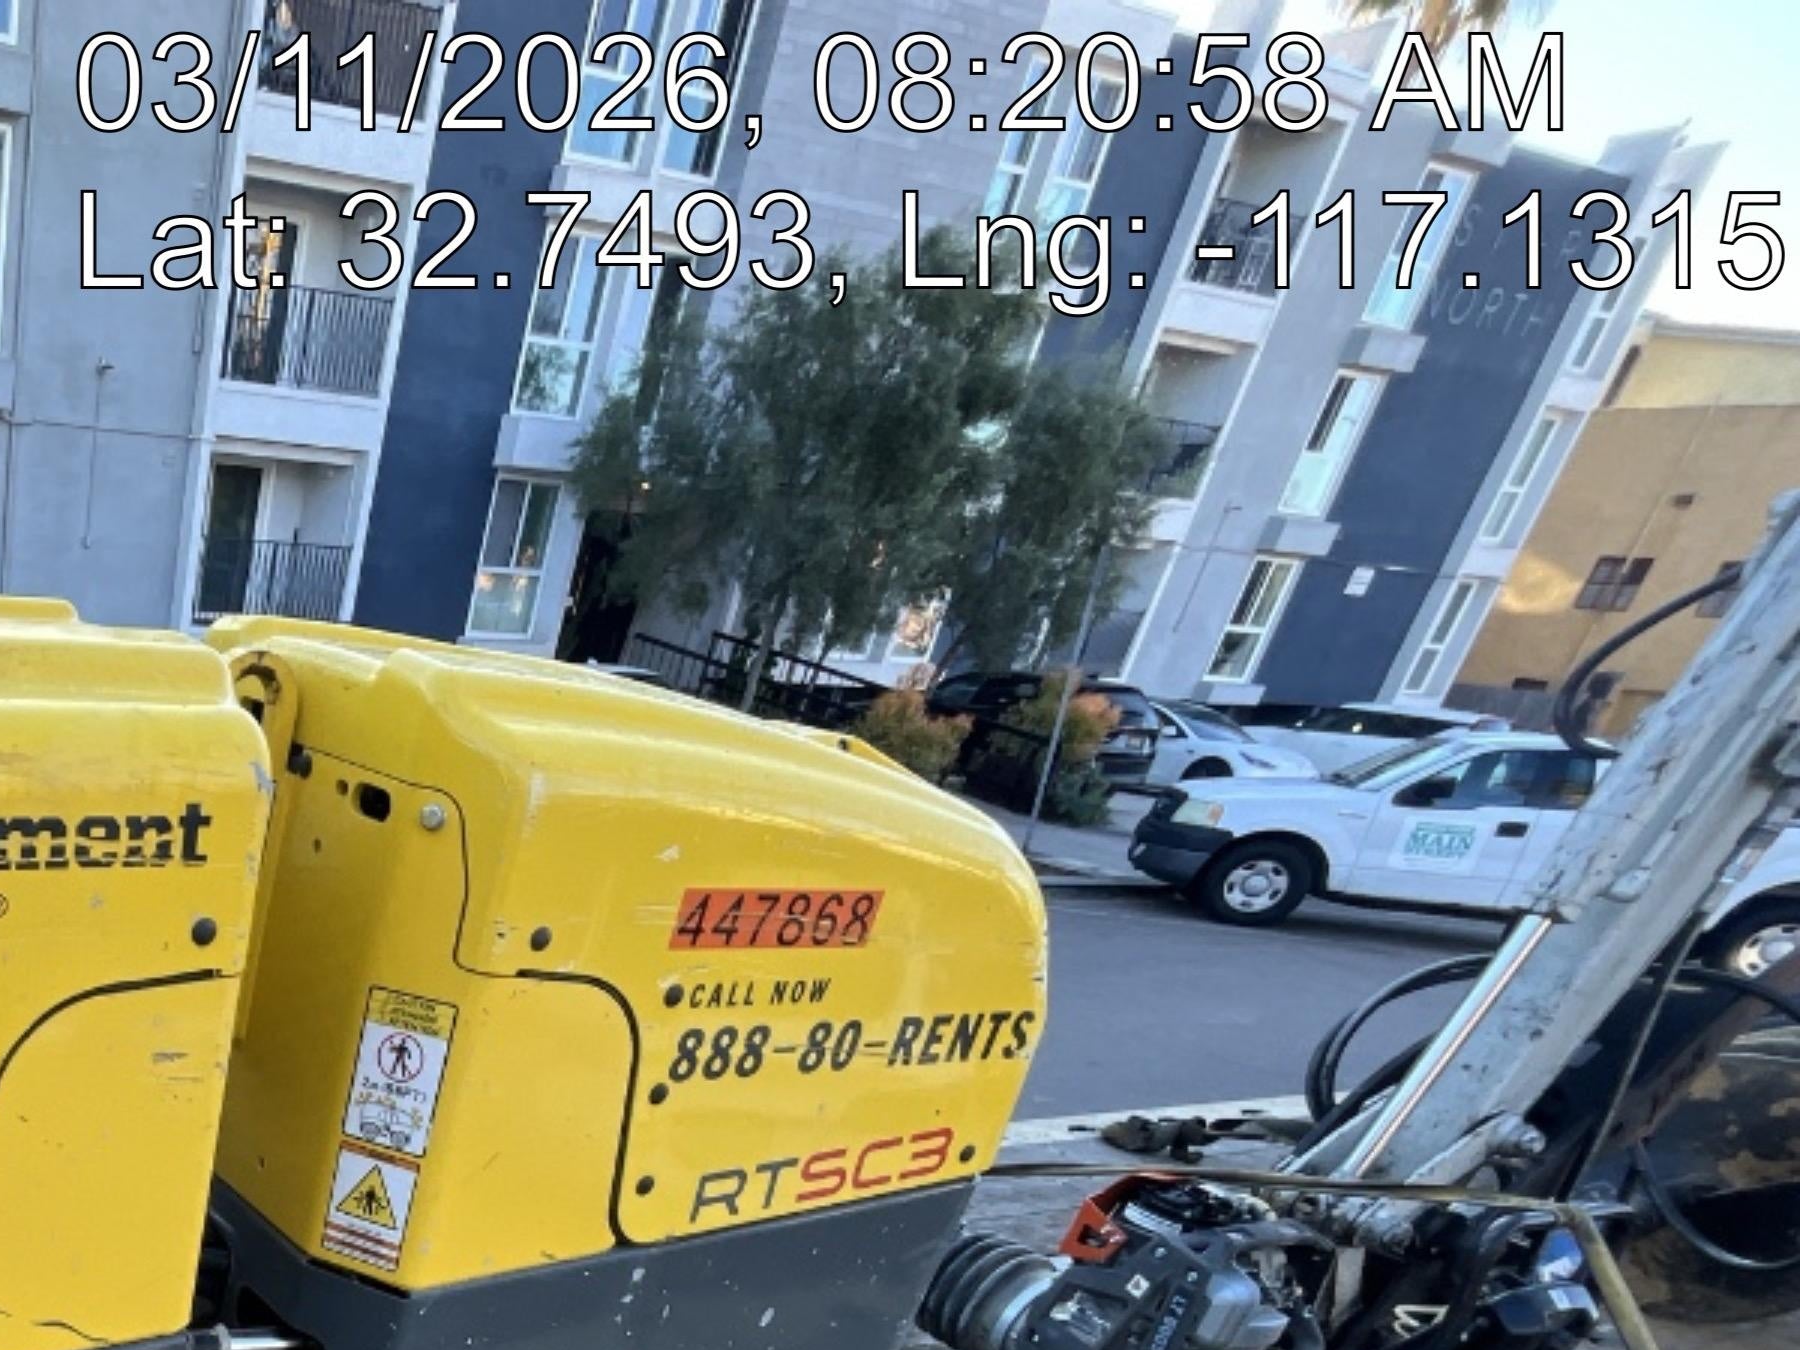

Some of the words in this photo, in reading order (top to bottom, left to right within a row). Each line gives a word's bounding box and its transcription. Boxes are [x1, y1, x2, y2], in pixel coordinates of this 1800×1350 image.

[677, 892, 877, 947] 447868
[688, 981, 756, 1009] CALL
[770, 977, 832, 1005] NOW
[668, 1010, 1035, 1083] 888-80-RENTS
[689, 1127, 955, 1224] RTSC3
